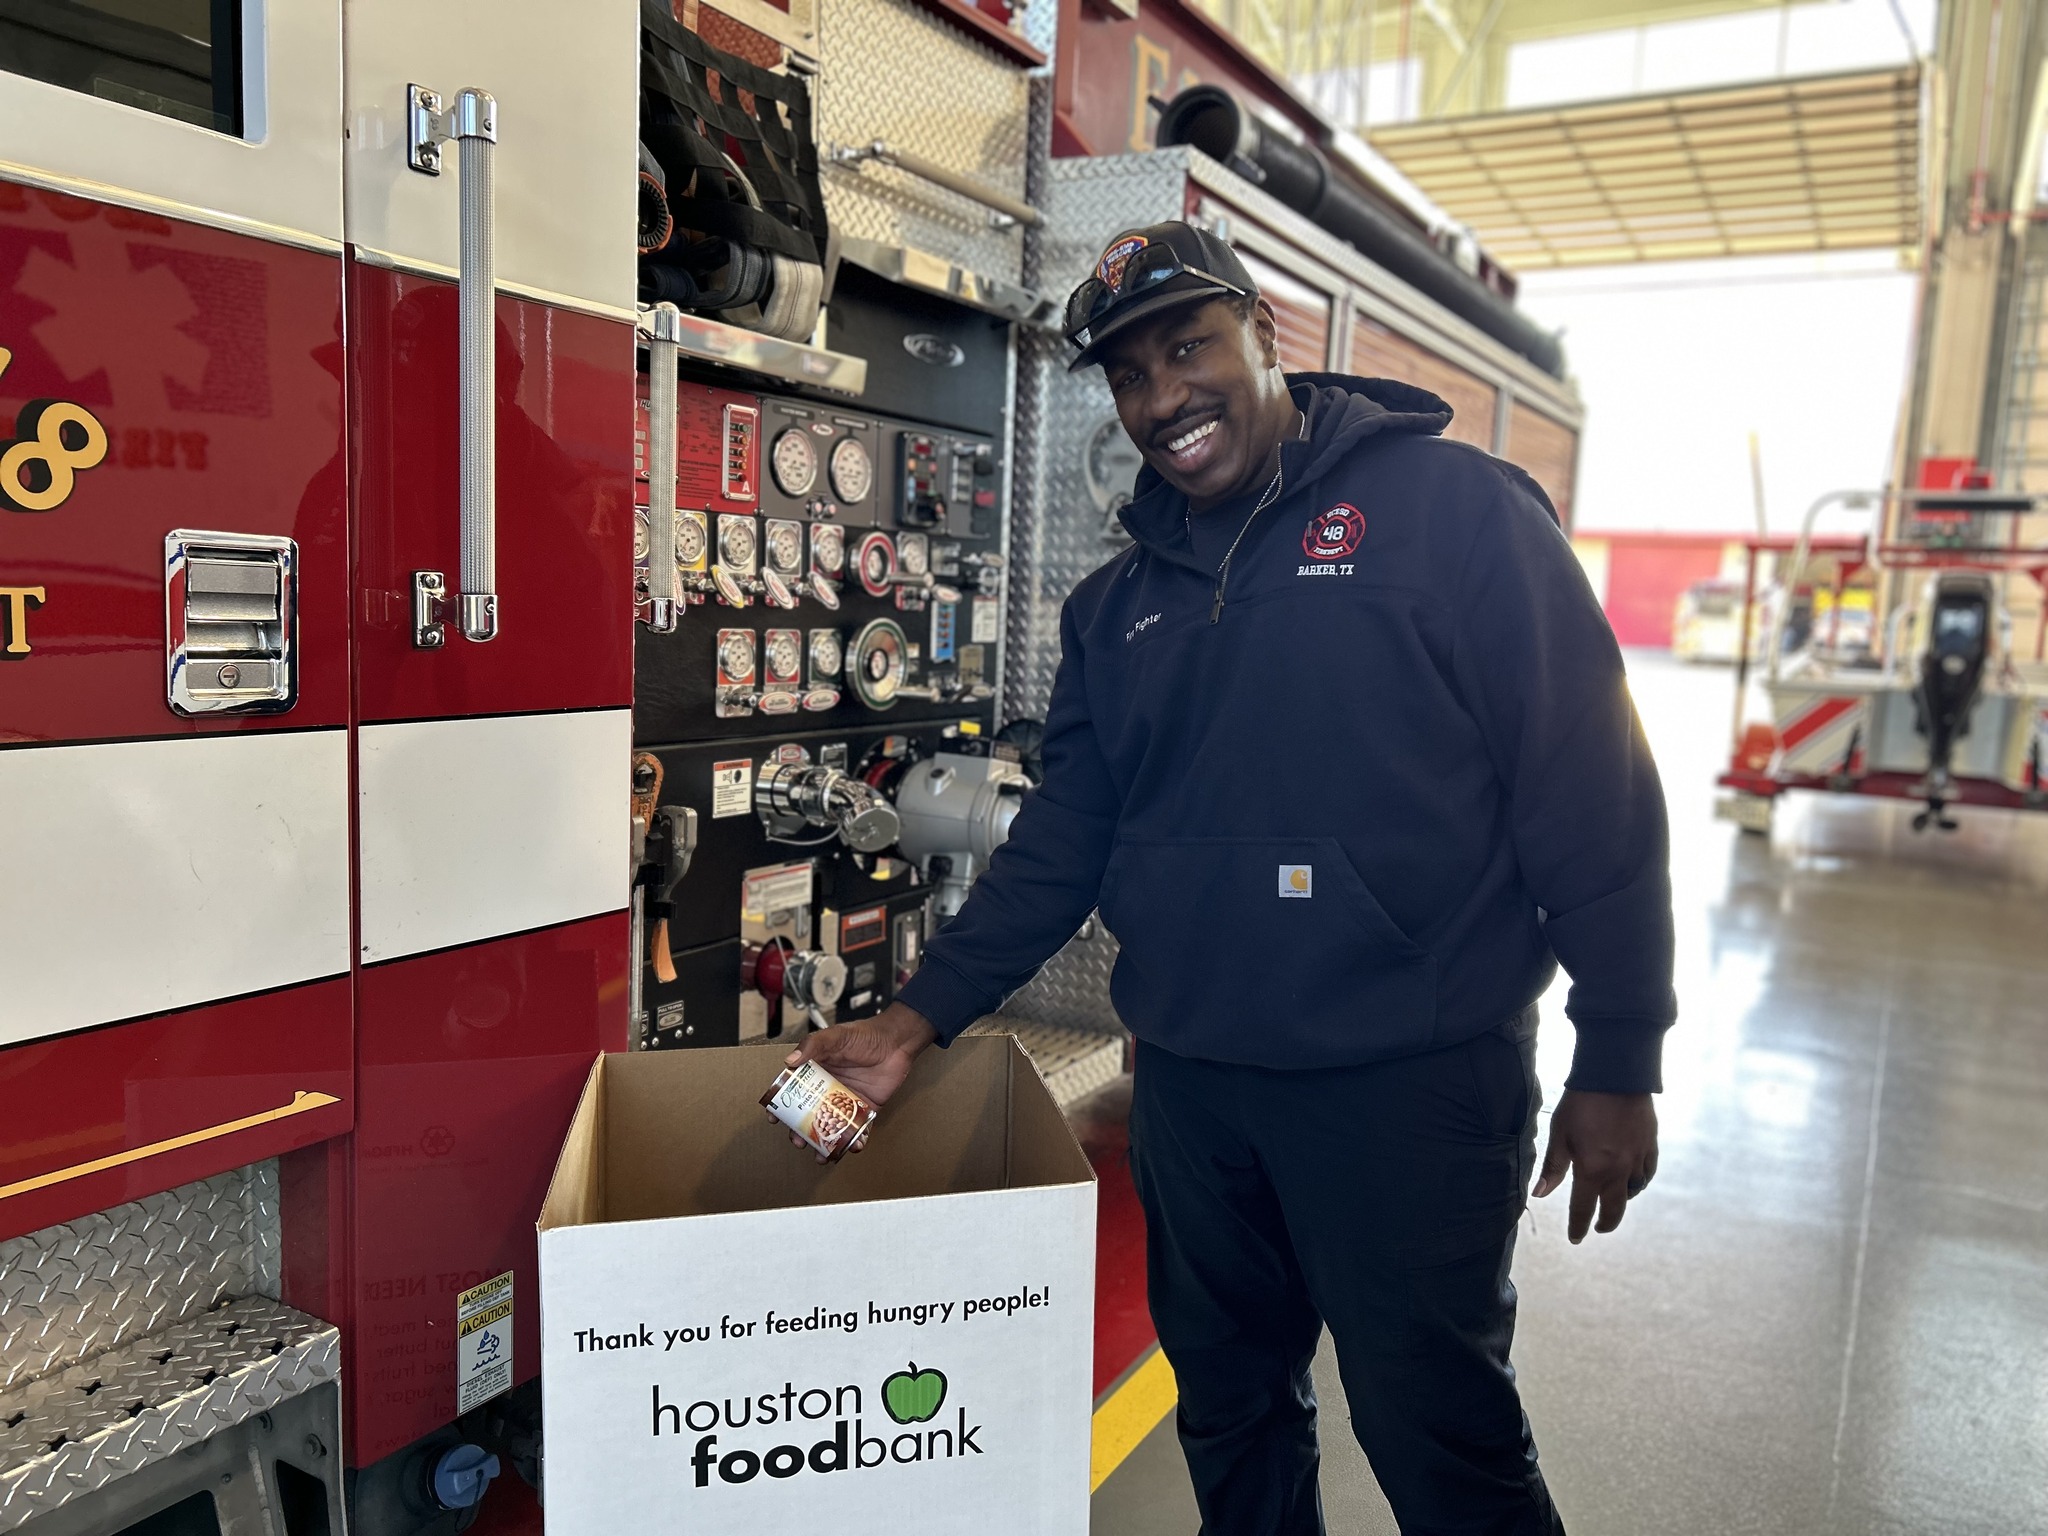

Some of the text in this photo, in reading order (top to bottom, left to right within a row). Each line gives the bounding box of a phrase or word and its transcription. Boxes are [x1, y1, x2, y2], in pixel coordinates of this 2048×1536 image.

[1323, 525, 1345, 540] 48
[1296, 564, 1355, 576] BARKER, TX
[781, 1068, 816, 1108] Organics
[797, 1093, 813, 1110] Pinto
[470, 1275, 510, 1300] CAUTION
[472, 1302, 510, 1329] CAUTION
[574, 1286, 1050, 1353] Thank you for feeding hungry people!
[651, 1383, 862, 1436] houston
[690, 1406, 985, 1488] foodbank
